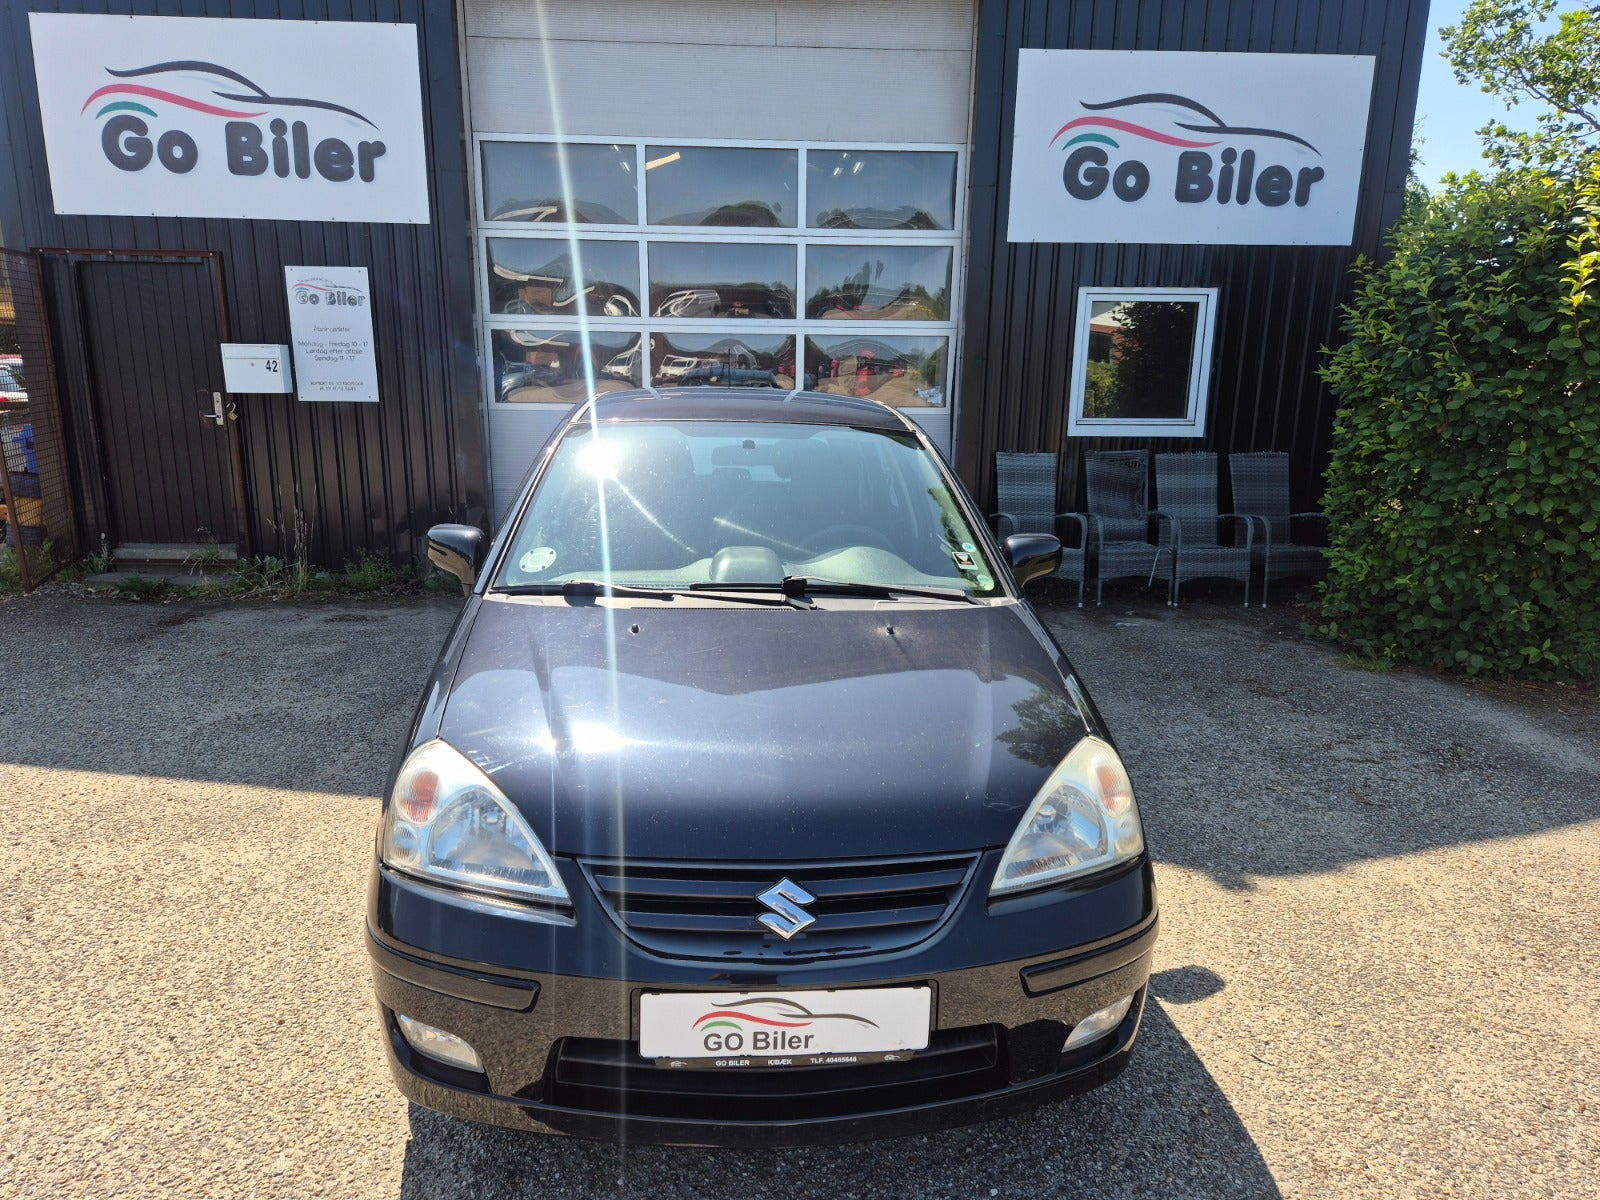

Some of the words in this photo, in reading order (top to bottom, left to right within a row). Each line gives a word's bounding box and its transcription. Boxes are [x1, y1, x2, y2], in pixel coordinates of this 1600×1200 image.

[101, 114, 199, 174] Go
[224, 118, 387, 183] Biler
[1062, 145, 1150, 202] Go
[1174, 147, 1325, 207] Biler
[295, 290, 320, 305] Go
[325, 290, 366, 306] Biler
[265, 359, 278, 373] 42
[703, 1032, 744, 1052] GO
[752, 1030, 814, 1051] Biler
[715, 1059, 727, 1067] GO
